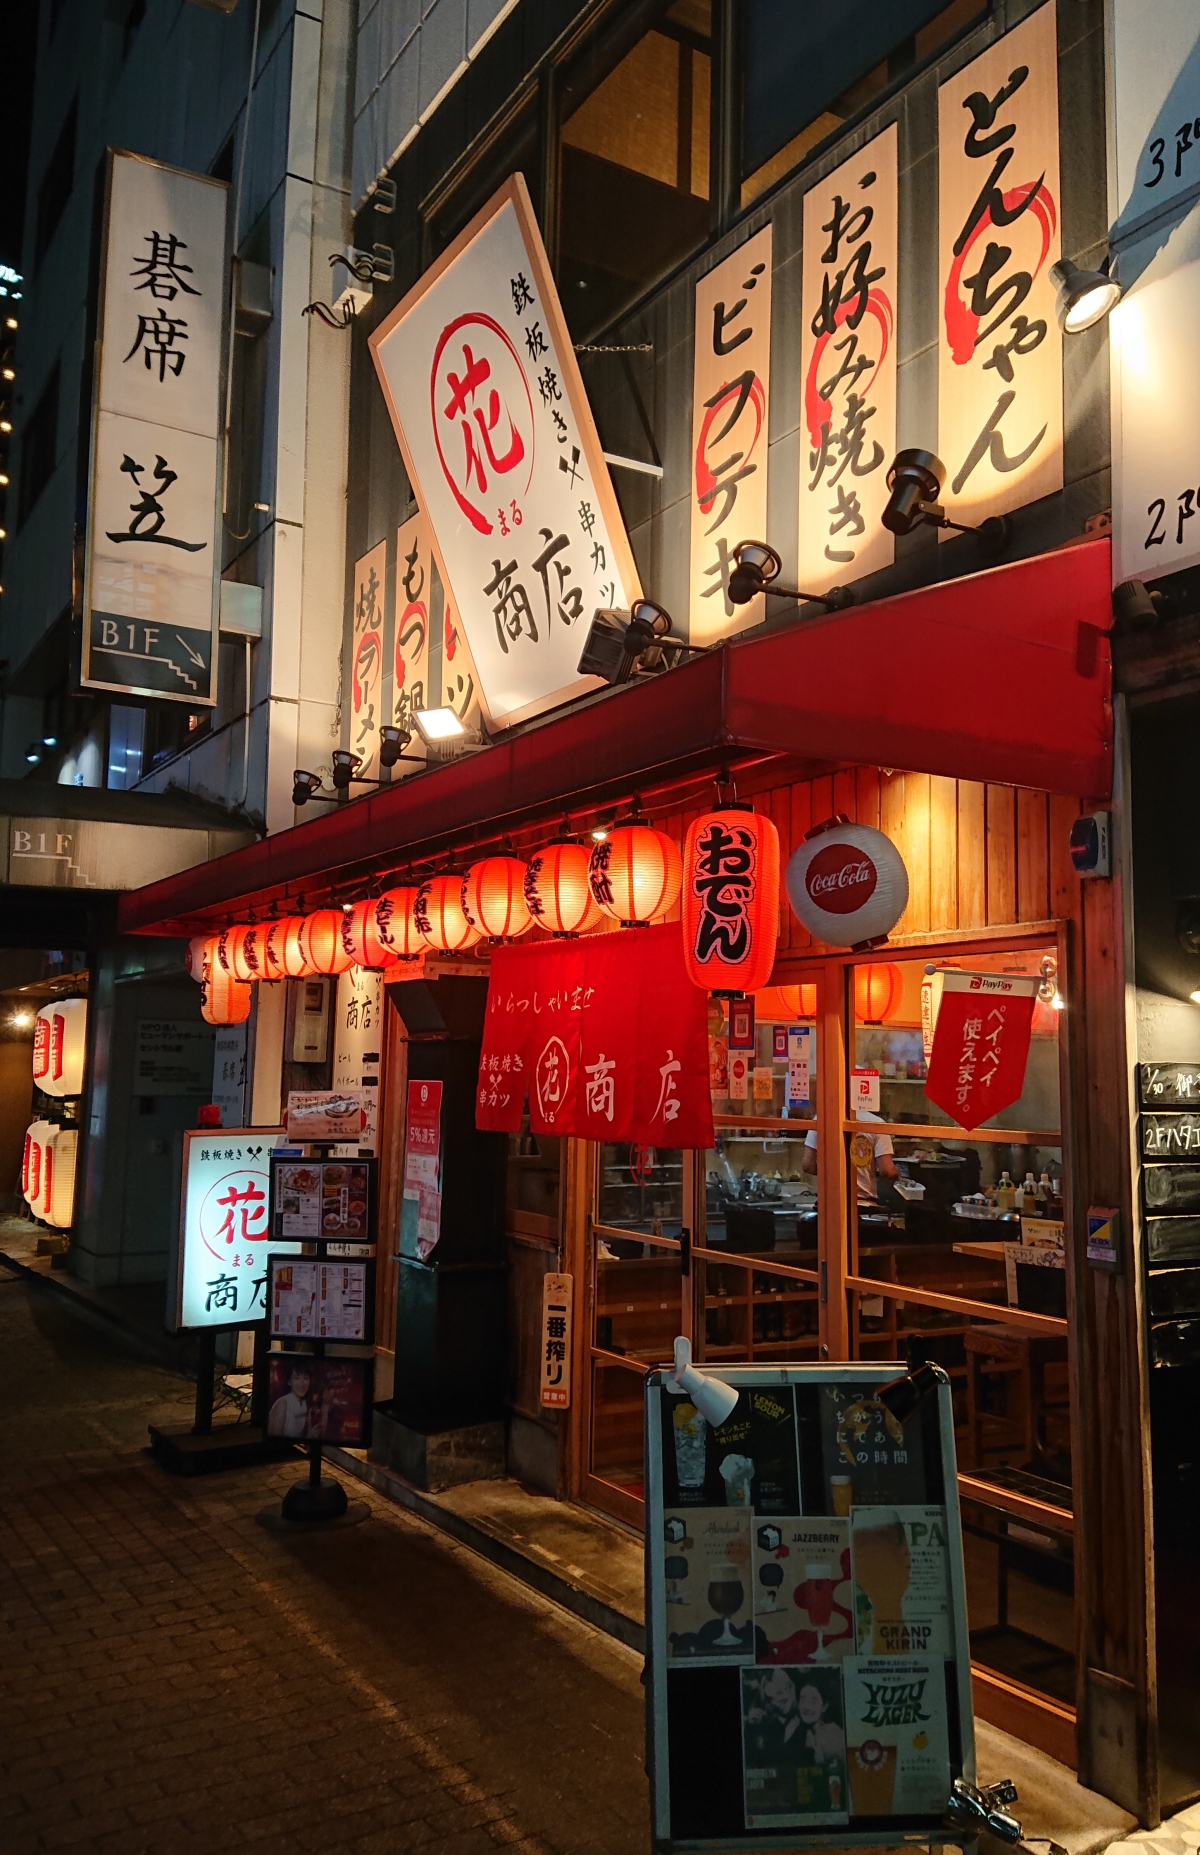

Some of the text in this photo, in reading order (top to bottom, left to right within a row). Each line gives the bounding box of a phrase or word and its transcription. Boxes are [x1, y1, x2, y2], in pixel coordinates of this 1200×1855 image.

[952, 65, 1049, 495] とんちゃん
[808, 171, 886, 563] お好み焼き
[106, 231, 208, 553] 碁席 笠
[443, 343, 526, 496] 花
[511, 273, 618, 609] 鉄板焼き 串カツ
[697, 263, 766, 618] ビフテキ
[497, 499, 524, 538] まる
[483, 527, 585, 655] 商店
[101, 620, 159, 654] B1F
[395, 536, 428, 734] もつ鍋
[354, 567, 384, 778] 焼ラーメン
[13, 830, 73, 854] B1F
[694, 822, 756, 963] おでん
[810, 861, 871, 897] Coca-Cola
[375, 898, 395, 945] 生ビール
[491, 986, 596, 1015] いらっしゃいませ
[982, 979, 1014, 991] PayPay
[346, 995, 373, 1031] 商店
[980, 1004, 1007, 1088] ペイペイ
[541, 1047, 561, 1103] 花
[956, 1017, 984, 1113] 使えます。
[480, 1088, 511, 1108] 串カツ
[584, 1050, 682, 1126] 商店
[200, 1148, 243, 1162] 鉄板焼き
[213, 1181, 269, 1245] 花
[231, 1253, 255, 1268] まる
[545, 1304, 567, 1386] 一番搾り
[753, 1393, 786, 1415] LEMON
[753, 1402, 780, 1419] SOUR
[713, 1421, 752, 1437] レモン丸ごと
[836, 1431, 904, 1443] にであう
[838, 1450, 908, 1465] この時間
[792, 1533, 841, 1544] JAZZBERRY
[894, 1521, 949, 1547] IPA
[879, 1626, 932, 1638] GRAND
[885, 1638, 928, 1650] KIRIN
[861, 1679, 928, 1706] YUZU
[861, 1702, 932, 1728] LAGER
